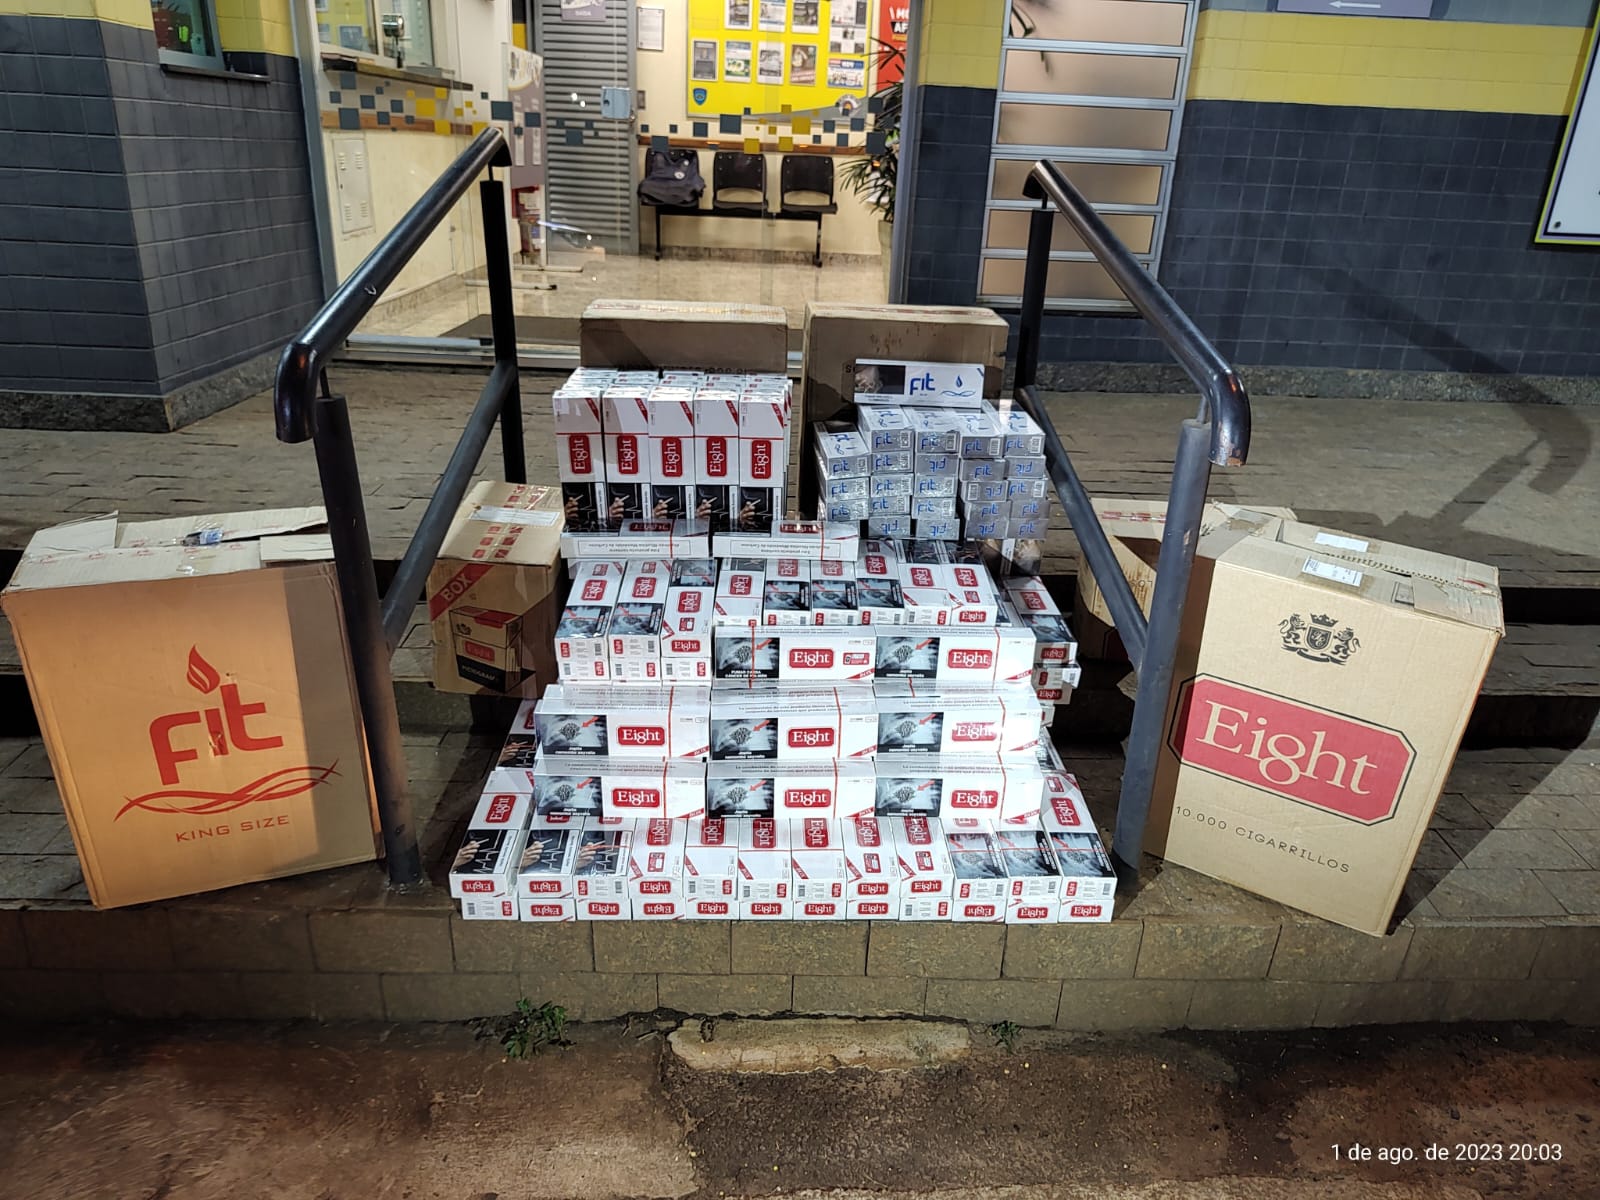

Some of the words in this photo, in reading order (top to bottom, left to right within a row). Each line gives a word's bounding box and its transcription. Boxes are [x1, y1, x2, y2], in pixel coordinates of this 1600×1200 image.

[572, 439, 588, 471] Eight
[621, 439, 636, 471] Eight
[664, 441, 680, 473] Eight
[709, 441, 725, 473] Eight
[754, 444, 770, 475] Eight
[440, 574, 472, 601] BOX
[961, 611, 984, 622] Eight
[673, 641, 698, 651] Eight
[793, 651, 830, 667] Eight
[952, 652, 989, 667] Eight
[622, 729, 661, 744] Eight
[792, 731, 830, 745] Eight
[1195, 699, 1378, 795] Eight
[617, 791, 656, 805] Eight
[789, 791, 827, 806] Eight
[956, 791, 994, 806] Eight
[490, 797, 511, 820] Eight
[1055, 800, 1074, 824] Eight
[176, 825, 231, 842] KING
[240, 814, 289, 832] SIZE
[756, 821, 773, 846] Eight
[807, 820, 825, 845] Eight
[859, 820, 877, 845] Eight
[1176, 805, 1228, 830] 10.000
[1235, 825, 1350, 873] CIGARRILLOS
[464, 880, 492, 892] Eight
[532, 881, 559, 892] Eight
[642, 882, 668, 893] Eight
[861, 884, 886, 893] Eight
[914, 880, 939, 891] Eight
[533, 905, 560, 915] Eight
[591, 903, 617, 914] Eight
[647, 903, 672, 914] Eight
[700, 903, 726, 913] Eight
[753, 903, 779, 914] Eight
[807, 904, 832, 914] Eight
[861, 903, 886, 914] Eight
[968, 905, 993, 917] Eight
[1020, 908, 1045, 918] Eight
[1073, 906, 1099, 916] Eight
